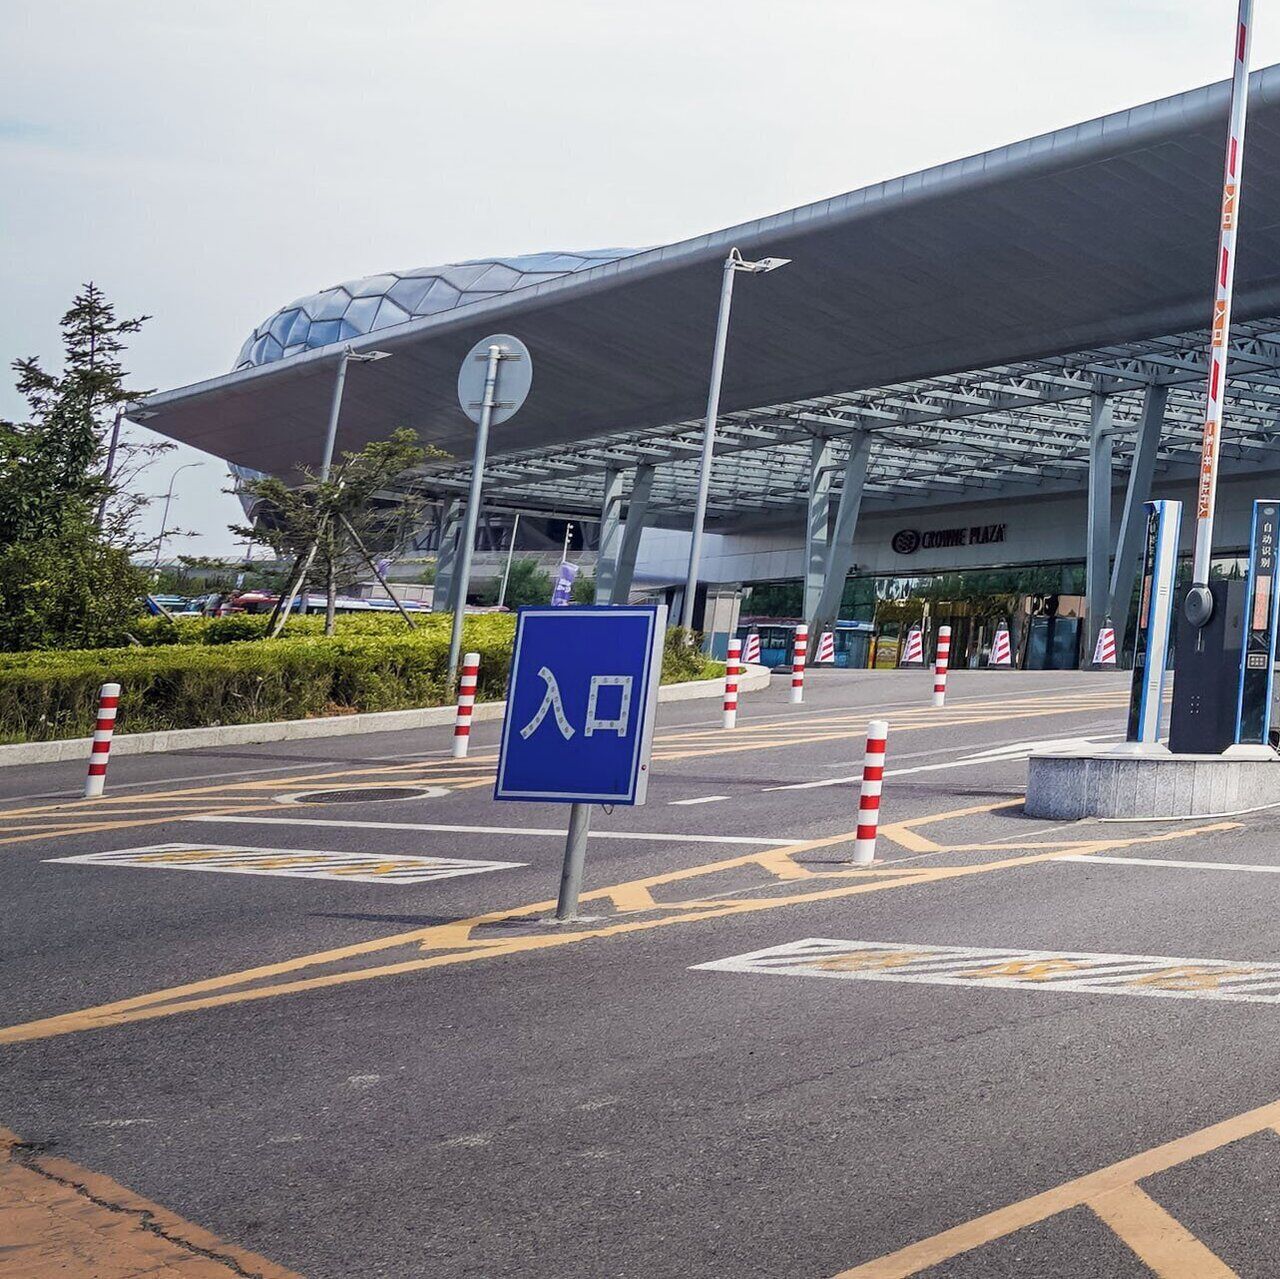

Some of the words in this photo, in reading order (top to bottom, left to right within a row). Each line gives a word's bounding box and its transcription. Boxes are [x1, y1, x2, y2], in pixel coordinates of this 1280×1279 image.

[1224, 191, 1234, 222] 入口
[1214, 306, 1225, 338] 入口
[922, 528, 968, 550] CROWNE
[968, 523, 1005, 546] PLAZA
[1260, 522, 1273, 568] 自动识别
[519, 666, 634, 741] 入口
